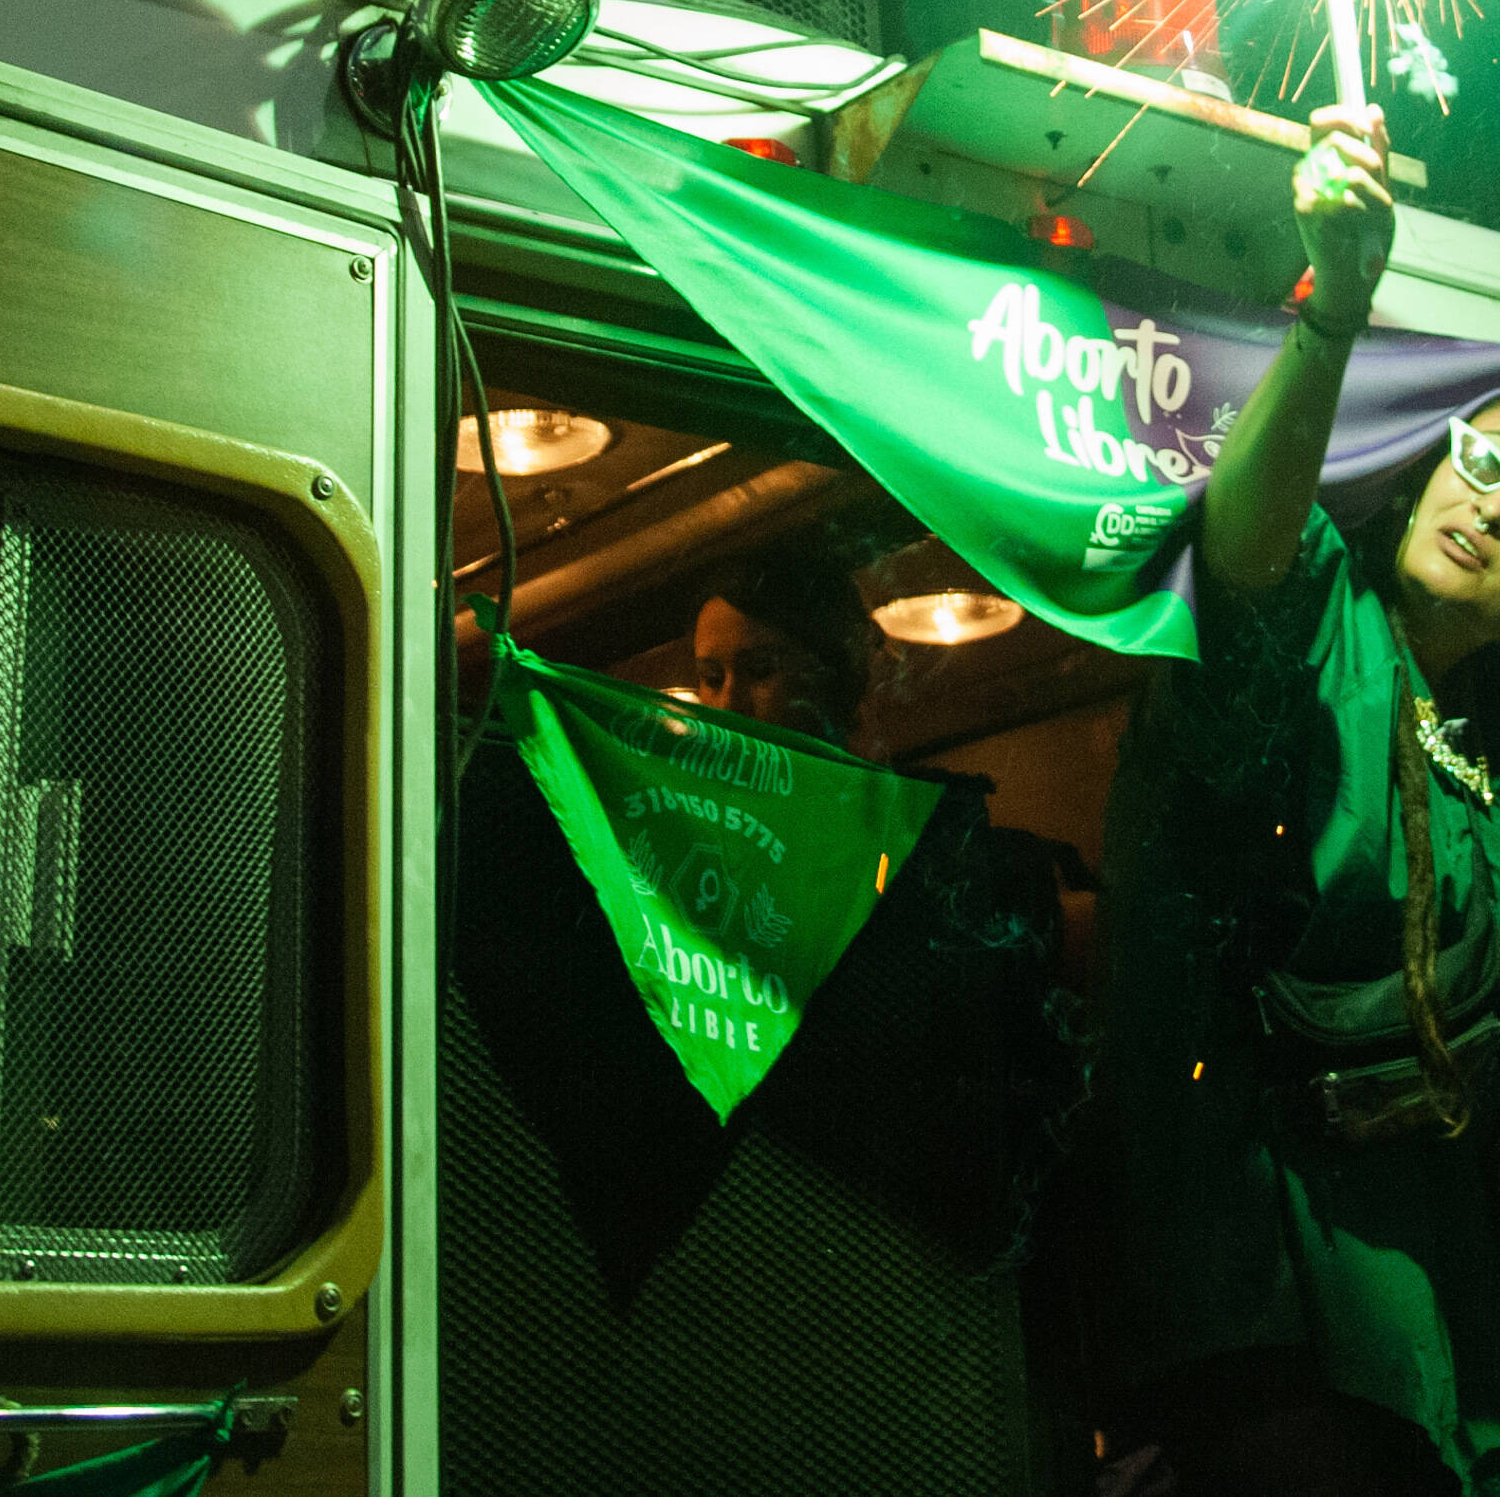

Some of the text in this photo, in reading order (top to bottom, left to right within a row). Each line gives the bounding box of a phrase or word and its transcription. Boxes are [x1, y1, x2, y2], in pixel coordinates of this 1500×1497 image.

[968, 283, 1191, 424] Aborto
[1037, 391, 1206, 485] Libre
[635, 912, 788, 1014] Aborto
[671, 996, 761, 1053] LIBRE
